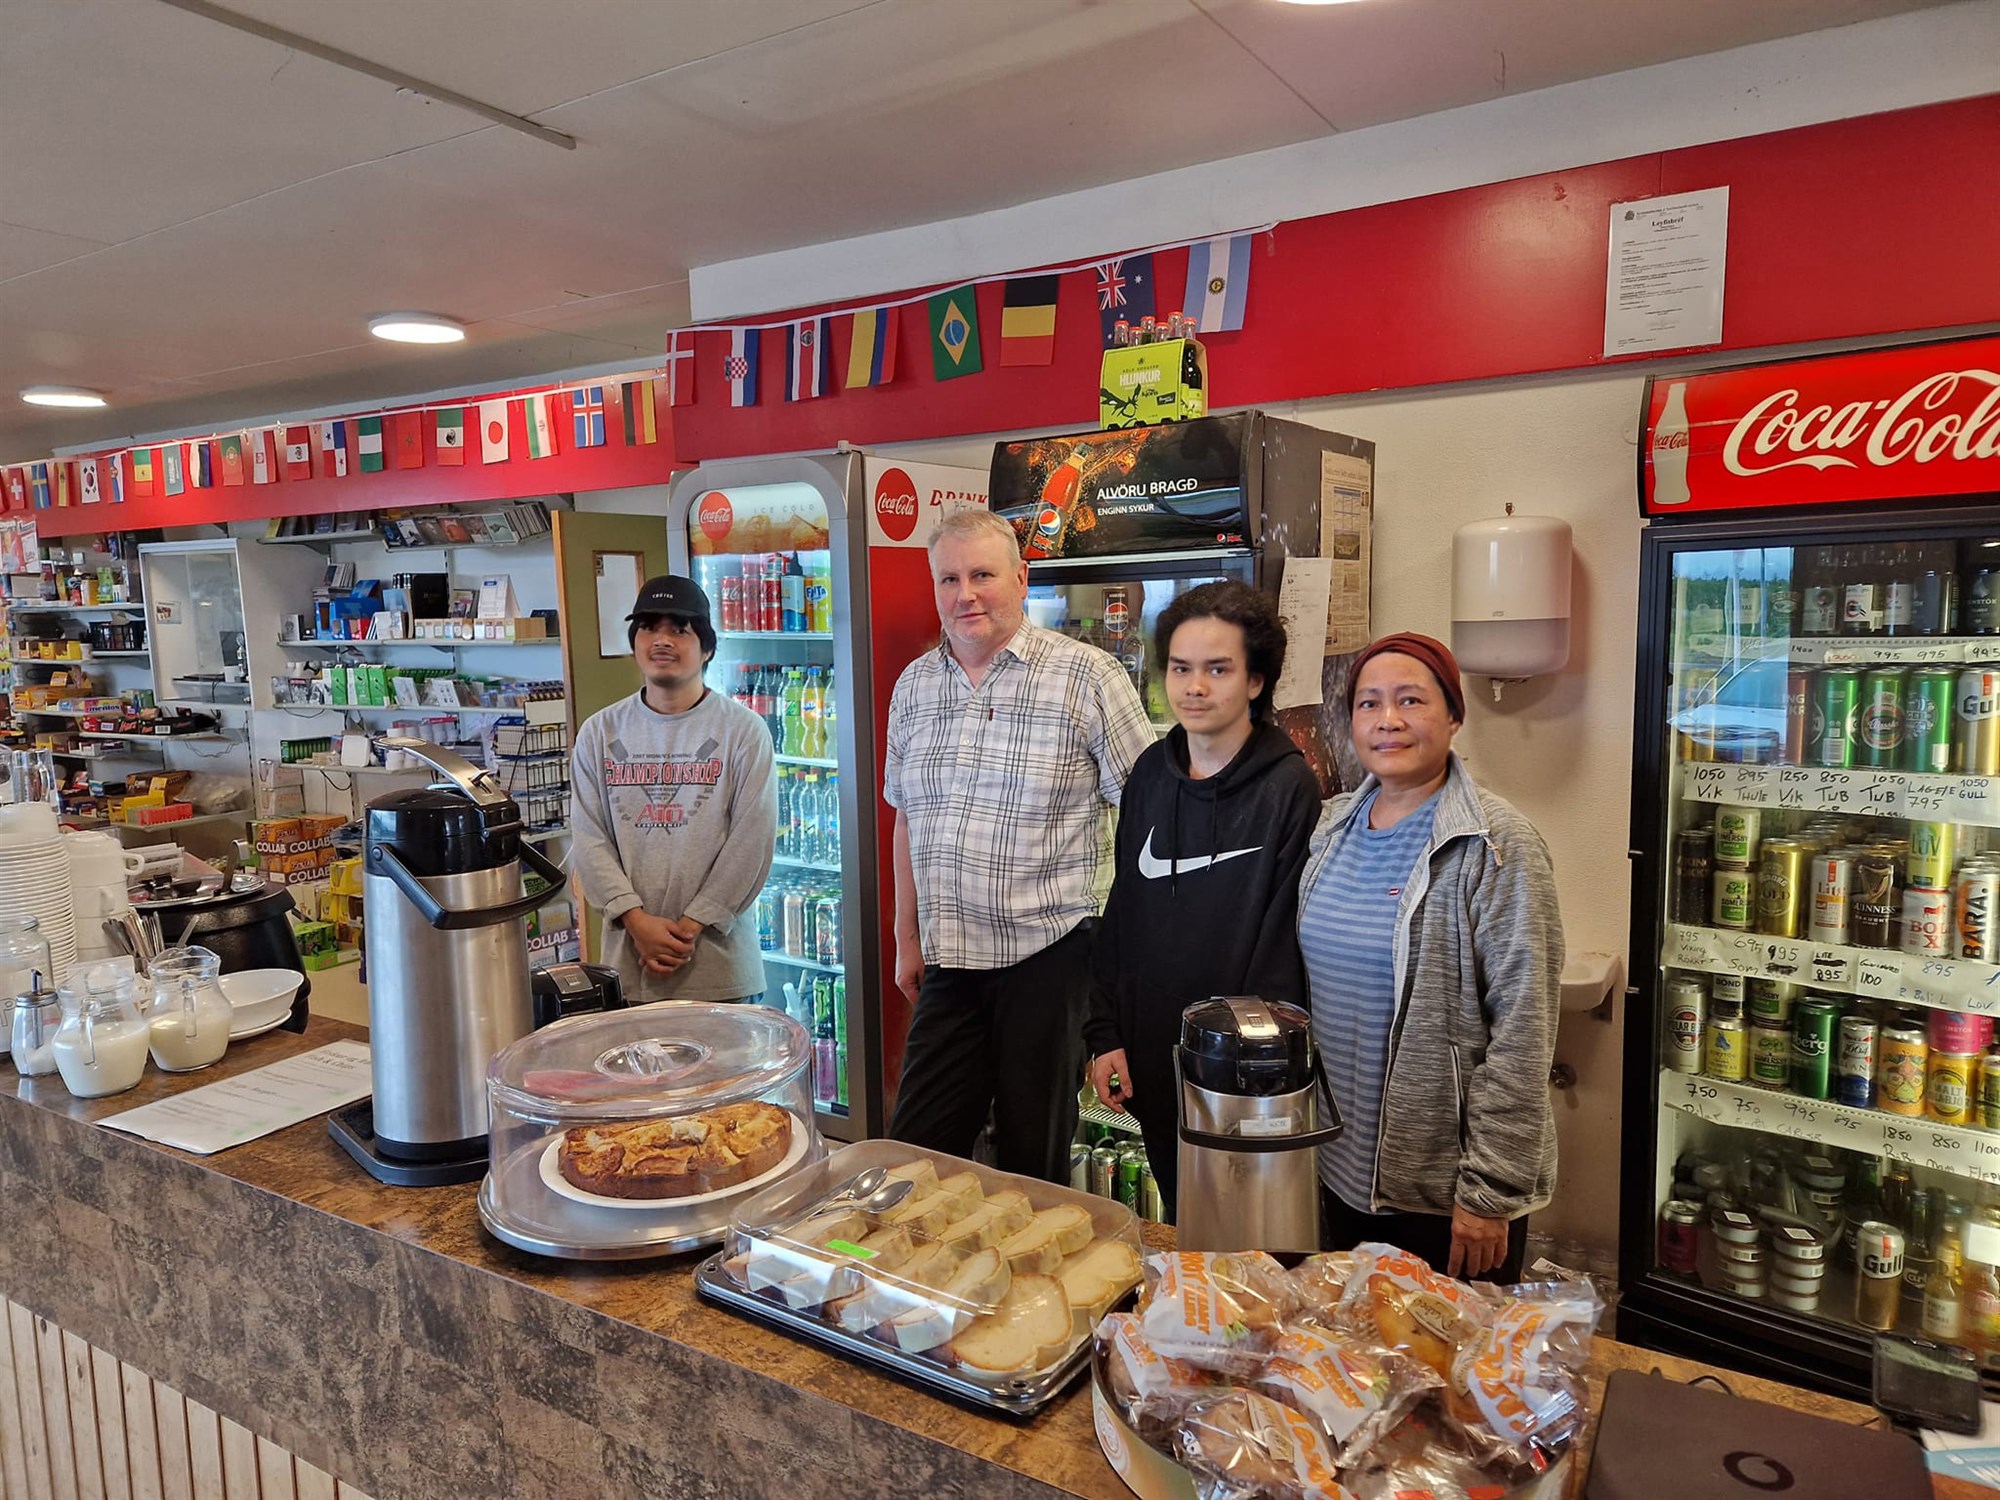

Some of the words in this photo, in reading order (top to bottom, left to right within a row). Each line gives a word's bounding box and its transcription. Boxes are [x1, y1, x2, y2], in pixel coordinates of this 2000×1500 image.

[1119, 369, 1161, 387] HLUNKUR
[1723, 369, 2000, 477] Coca-Cola
[1096, 482, 1147, 501] ALVÖRU
[1149, 477, 1199, 495] BRAGÐ
[753, 505, 775, 515] ICE
[782, 503, 815, 514] COLD
[876, 492, 915, 517] Coca-Cola
[1128, 503, 1155, 514] SYKUR
[699, 506, 733, 524] Coca-Cola
[89, 704, 120, 712] mentos
[603, 757, 724, 786] CHAMPIONSHIP
[1693, 767, 1726, 781] 1050
[1738, 768, 1769, 782] 895
[1779, 769, 1809, 783] 1250
[1819, 771, 1850, 784] 850
[1872, 774, 1906, 786] 1050
[1960, 779, 1989, 788] 1050
[1958, 789, 1987, 799] GULL
[1909, 796, 1944, 811] 795
[256, 841, 287, 854] COLLAB
[289, 835, 333, 854] COLLAB
[1679, 930, 1700, 942] 795
[1815, 951, 1834, 959] LITE
[1922, 961, 1955, 978] 895
[1860, 971, 1883, 986] 1100
[1685, 1083, 1718, 1099] 750
[1733, 1097, 1761, 1115] 750
[1783, 1103, 1819, 1123] 995
[1834, 1114, 1862, 1130] 895
[1883, 1125, 1913, 1142] 1850
[1931, 1133, 1961, 1150] 850
[1864, 1252, 1903, 1275] Gull
